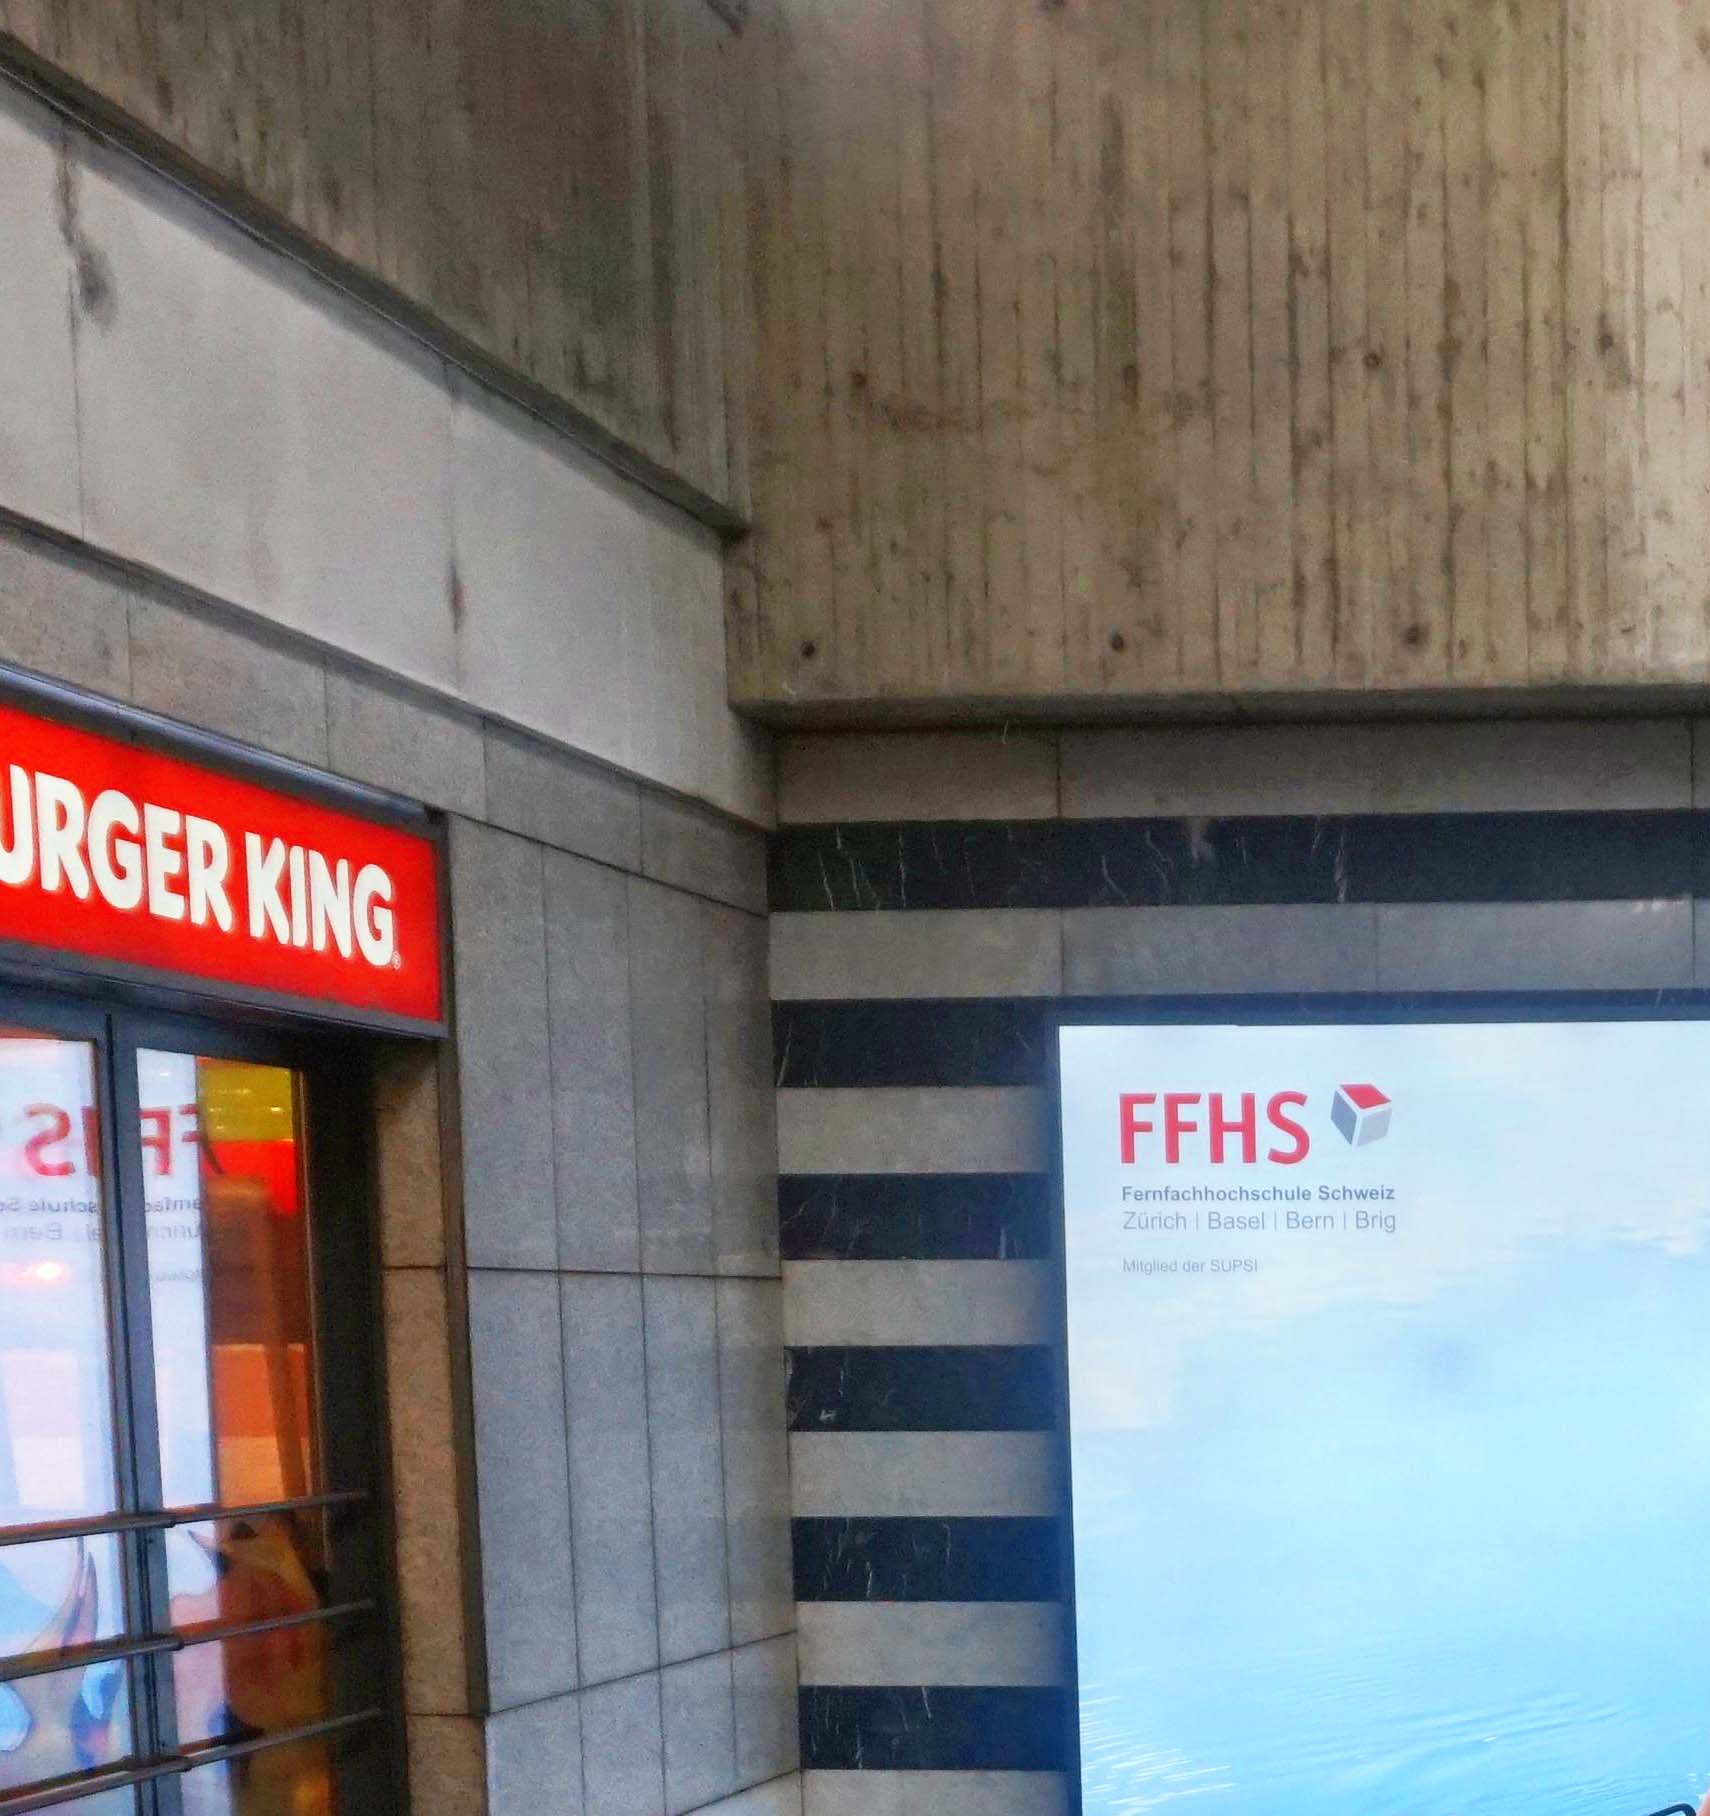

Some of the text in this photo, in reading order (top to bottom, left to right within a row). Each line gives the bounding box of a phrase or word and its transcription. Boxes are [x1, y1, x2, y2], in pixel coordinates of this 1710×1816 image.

[245, 831, 394, 967] KING
[1119, 1090, 1311, 1165] FFHS
[1121, 1184, 1396, 1201] Fernfachhochschule Schweiz
[1122, 1209, 1397, 1234] Zürich Basel Bern Brig
[1122, 1258, 1258, 1276] Mitglied der SUPSI
